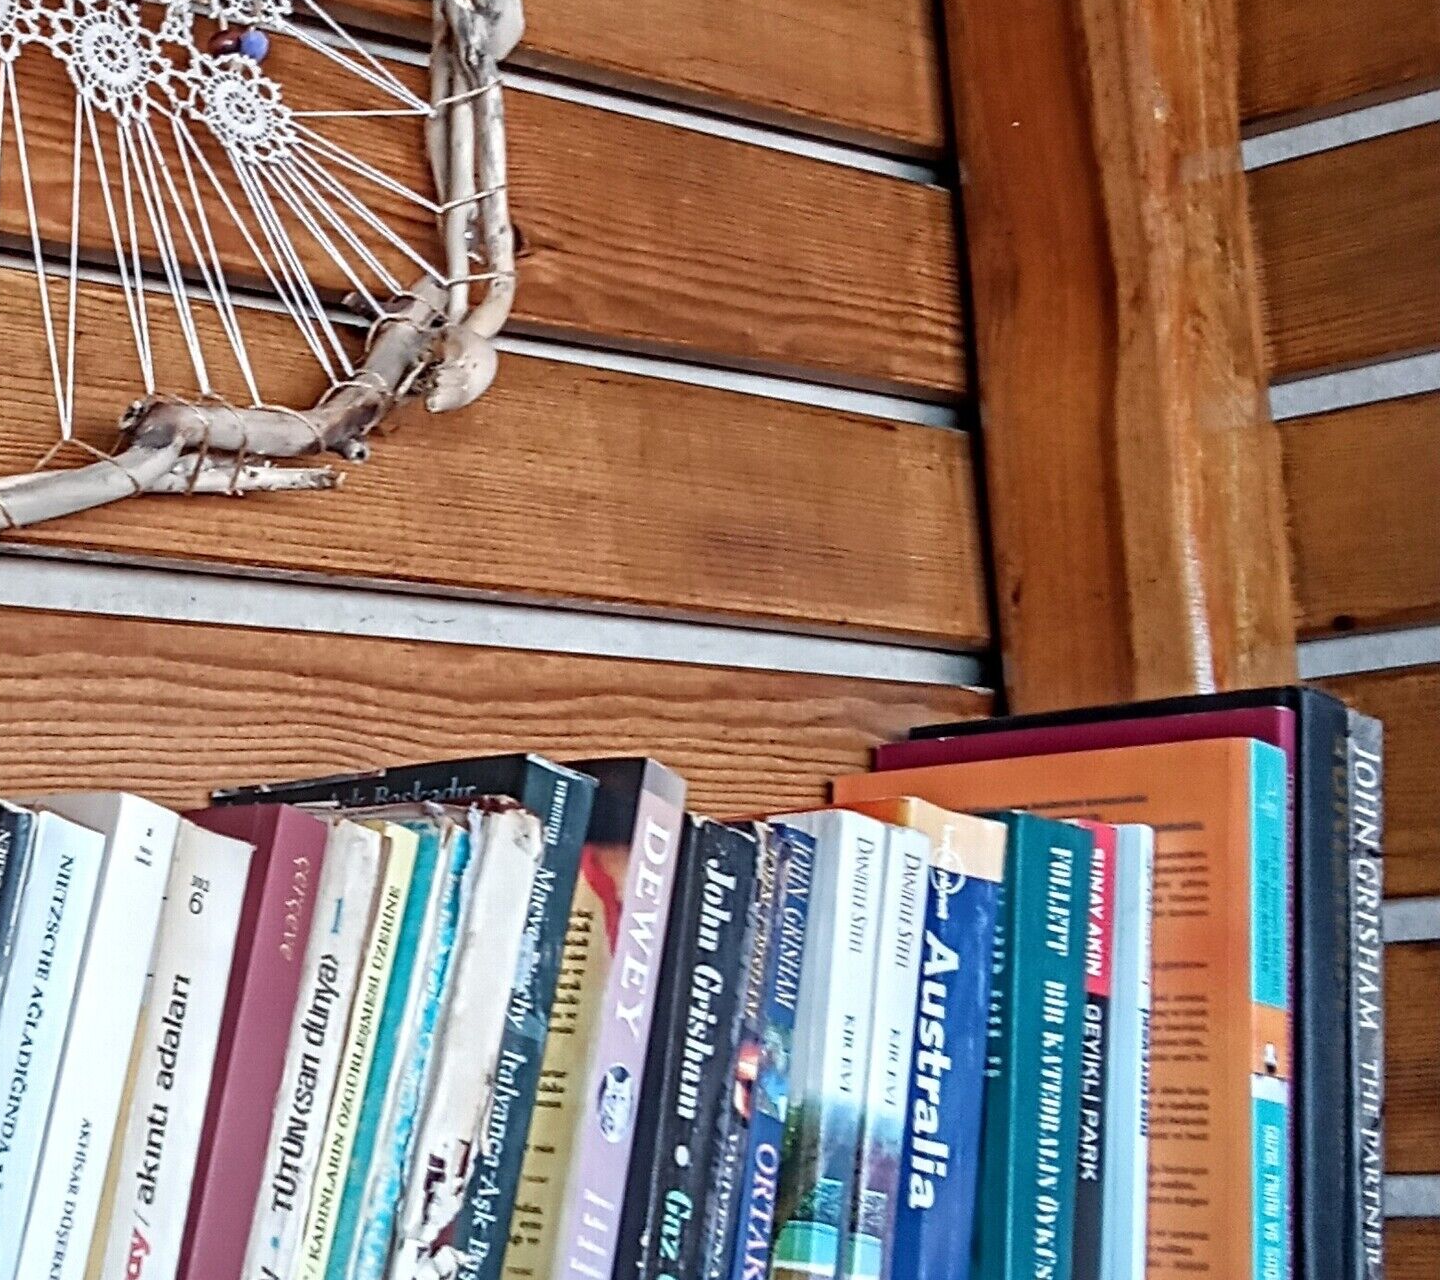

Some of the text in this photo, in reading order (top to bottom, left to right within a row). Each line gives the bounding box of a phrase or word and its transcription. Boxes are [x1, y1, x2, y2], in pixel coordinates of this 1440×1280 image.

[696, 858, 738, 951] John
[785, 840, 815, 897] JOHN
[1044, 847, 1072, 956] FOLLETT
[610, 817, 675, 1038] DEWEY
[770, 906, 809, 1011] GRISHAM
[1084, 924, 1104, 977] AKIN
[150, 973, 190, 1090] adaları
[675, 965, 724, 1121] Grisham
[1042, 979, 1068, 1023] BİR
[1353, 747, 1381, 1263] JOHN GRISHAM THE PARTNER
[907, 928, 962, 1211] Australia
[1034, 1030, 1067, 1189] KATEDRALİN
[132, 1102, 169, 1205] akıntı
[267, 1115, 309, 1216] TÜTÜN
[1078, 1109, 1102, 1182] PARK
[305, 1135, 347, 1262] KADINLARIN
[466, 1172, 503, 1229] Aşk
[659, 1189, 694, 1260] Gaz
